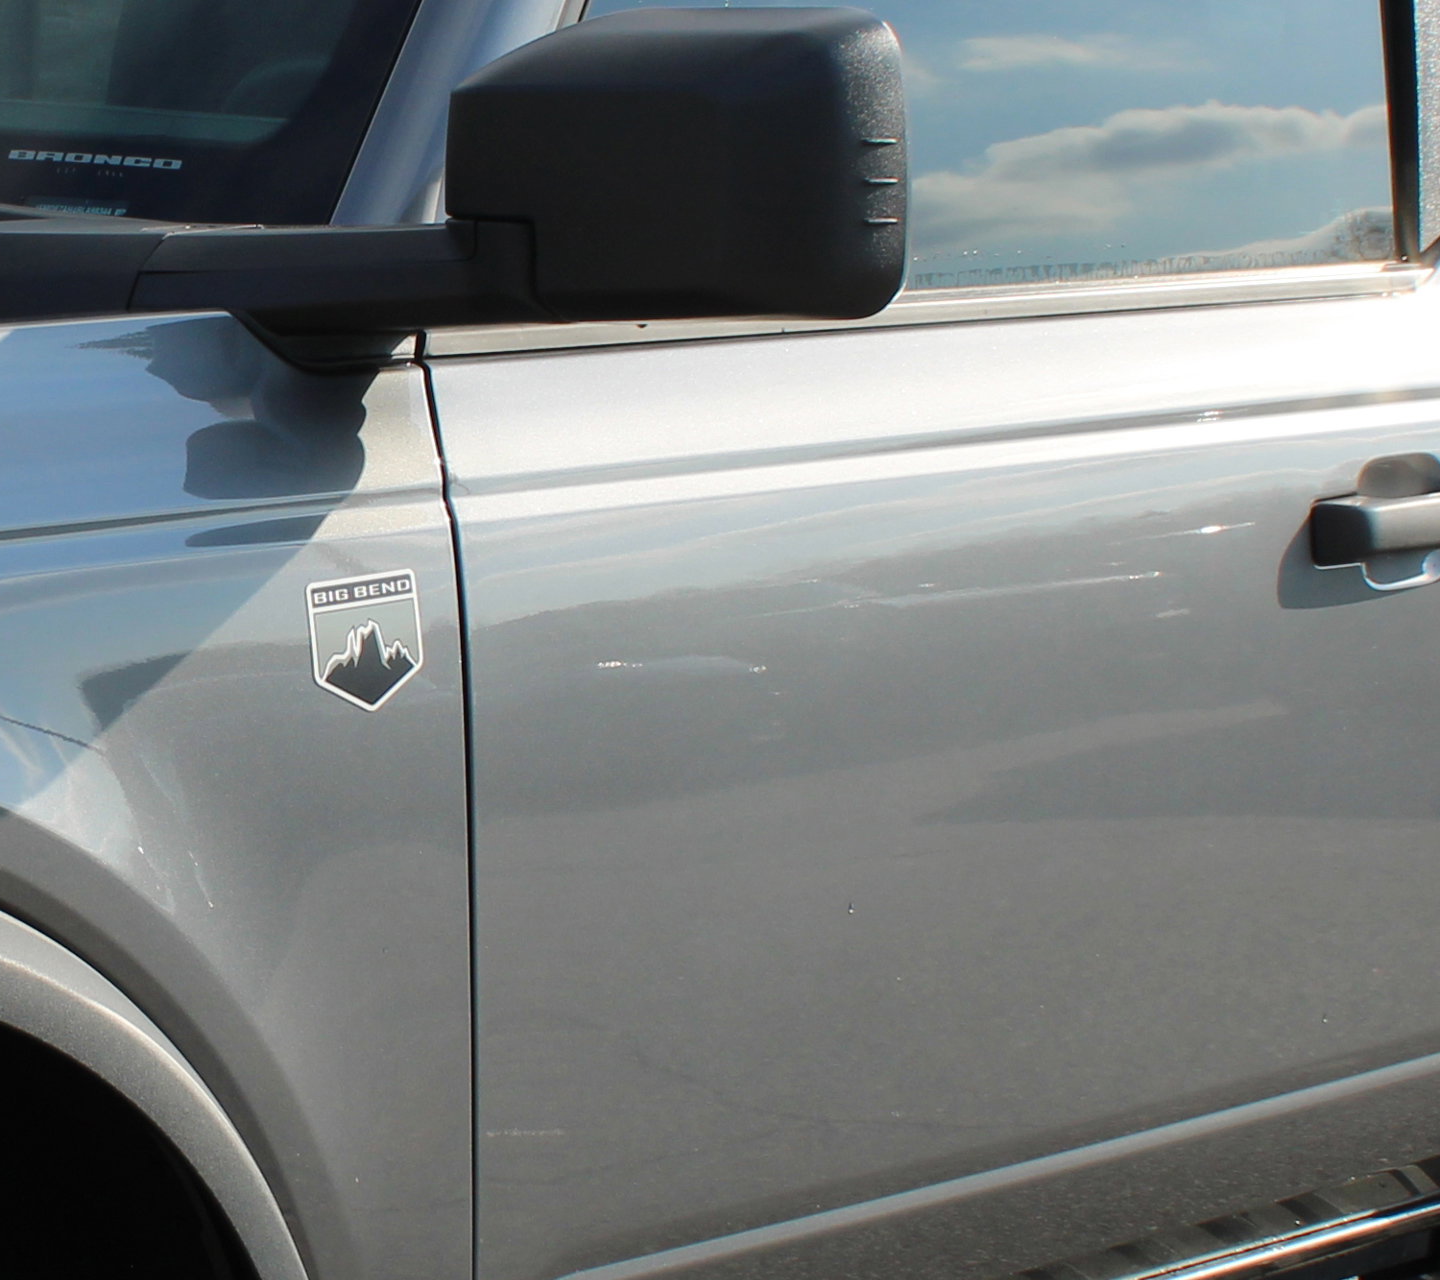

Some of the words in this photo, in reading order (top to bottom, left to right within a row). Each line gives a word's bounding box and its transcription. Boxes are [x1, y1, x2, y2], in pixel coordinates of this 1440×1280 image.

[8, 149, 183, 170] BRONCO
[313, 588, 349, 605] BIG
[354, 579, 410, 598] BEND
